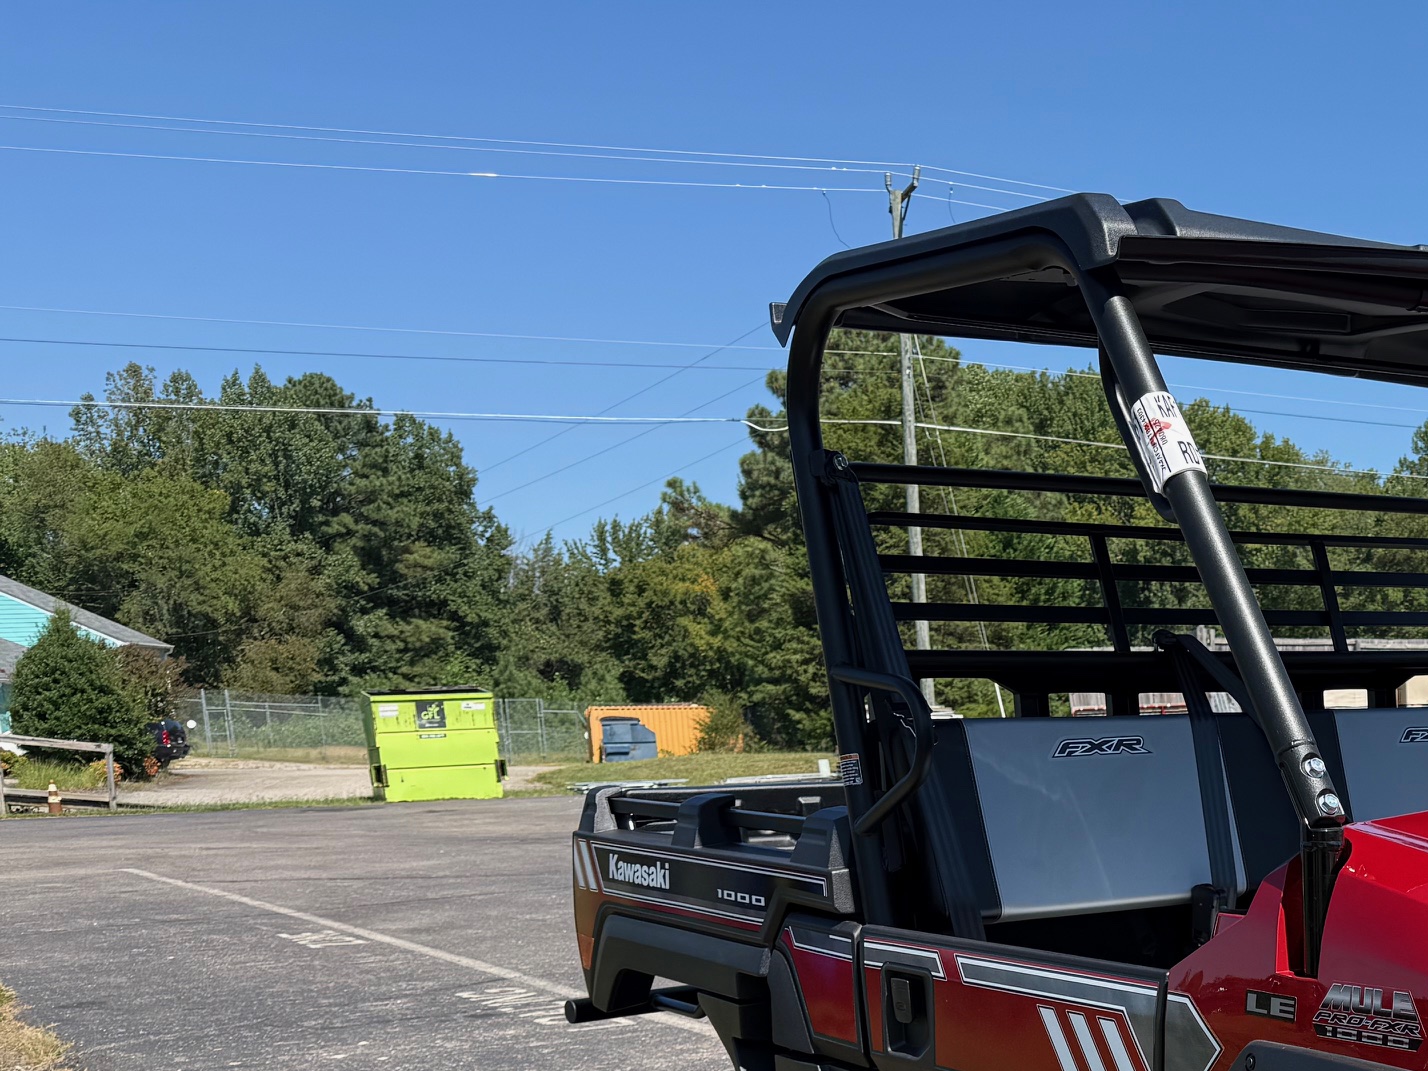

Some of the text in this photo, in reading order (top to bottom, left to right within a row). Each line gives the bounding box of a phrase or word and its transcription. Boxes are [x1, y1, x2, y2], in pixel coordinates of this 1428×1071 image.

[1051, 735, 1153, 759] FXR
[609, 853, 670, 890] Kawasaki
[717, 888, 765, 907] 1000
[1247, 993, 1296, 1018] LE
[1318, 983, 1419, 1023] MULE
[1312, 1010, 1422, 1038] PRO-FXR
[1325, 1026, 1410, 1049] 1000
